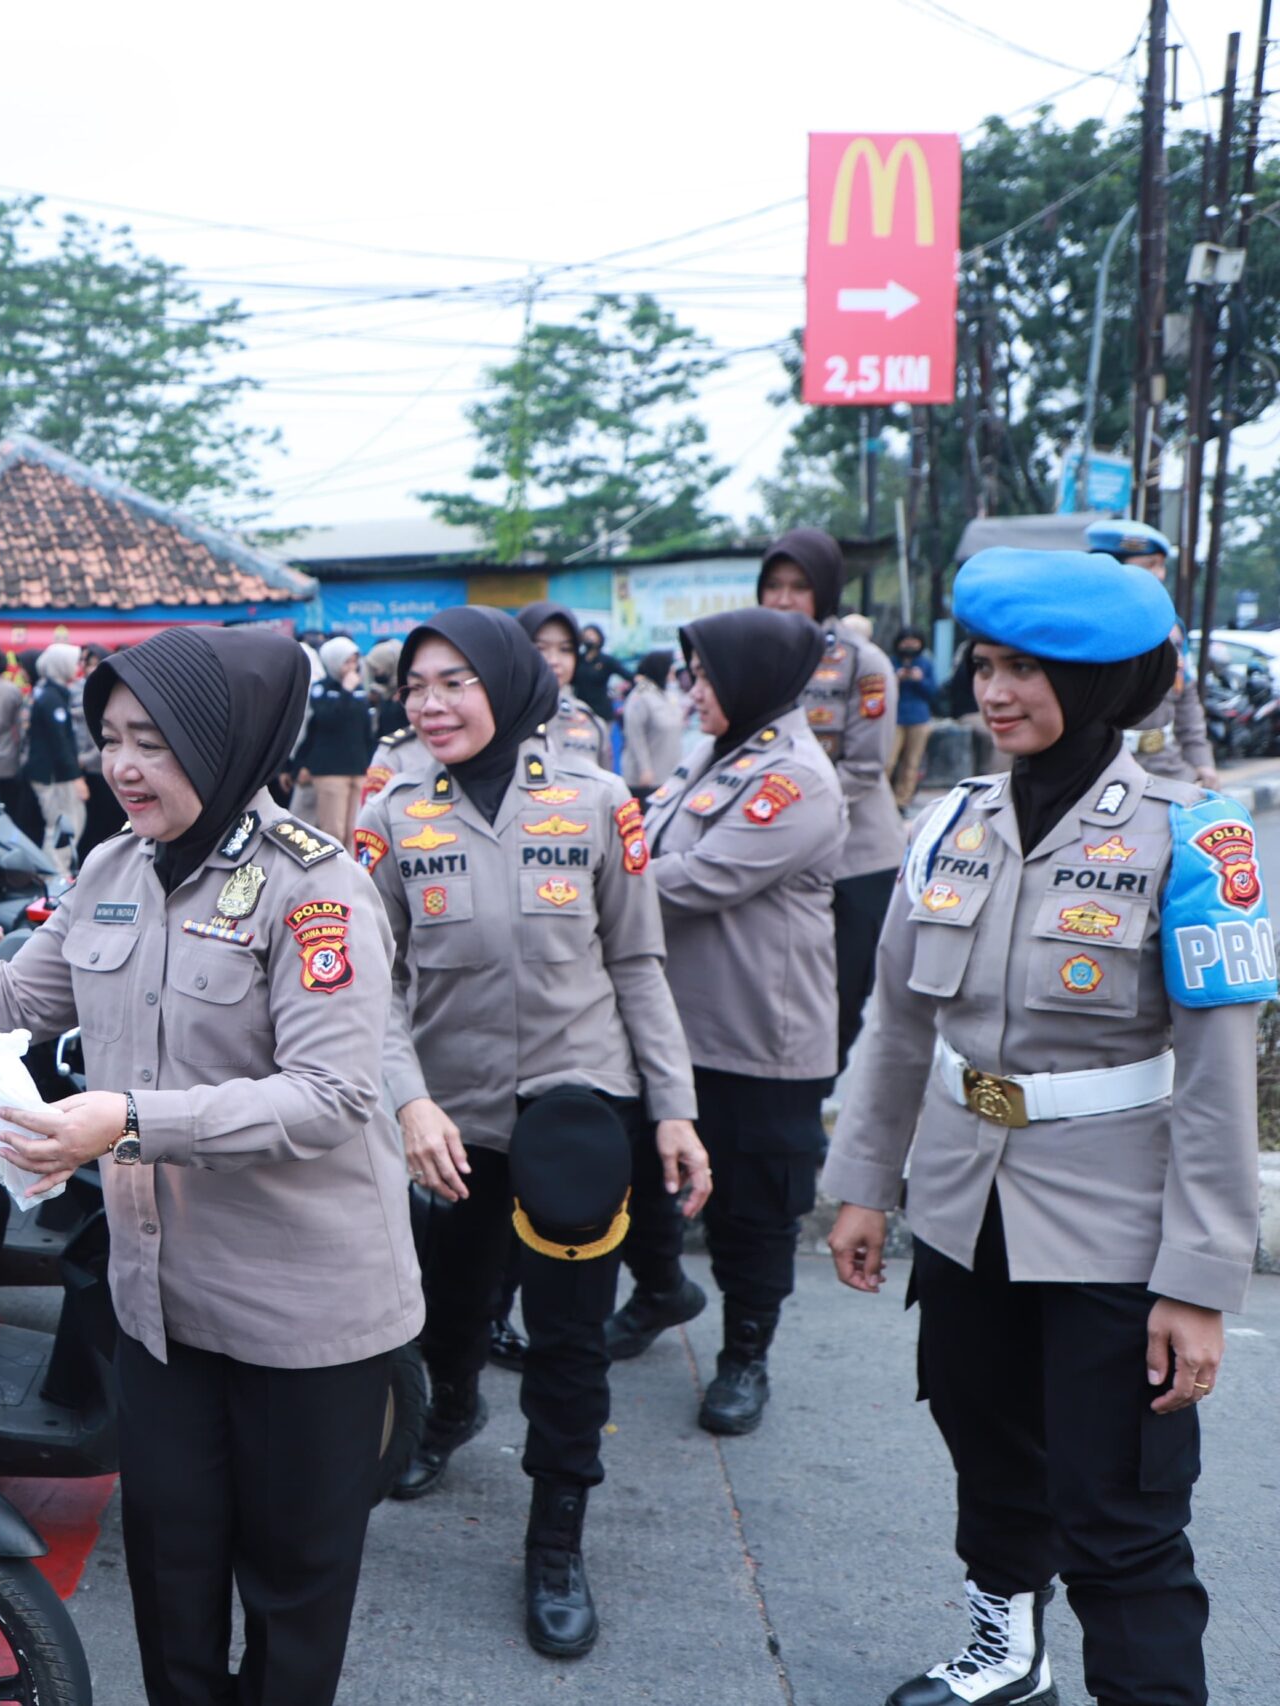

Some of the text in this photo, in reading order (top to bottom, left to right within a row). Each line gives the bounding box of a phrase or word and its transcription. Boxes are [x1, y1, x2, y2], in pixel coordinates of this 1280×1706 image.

[822, 354, 931, 399] 2,5 KM
[1203, 827, 1251, 847] POLDA
[522, 847, 589, 866] POLRI
[1053, 869, 1148, 894] POLRI
[293, 903, 343, 923] POLDA
[301, 927, 345, 940] JAWA BARAT
